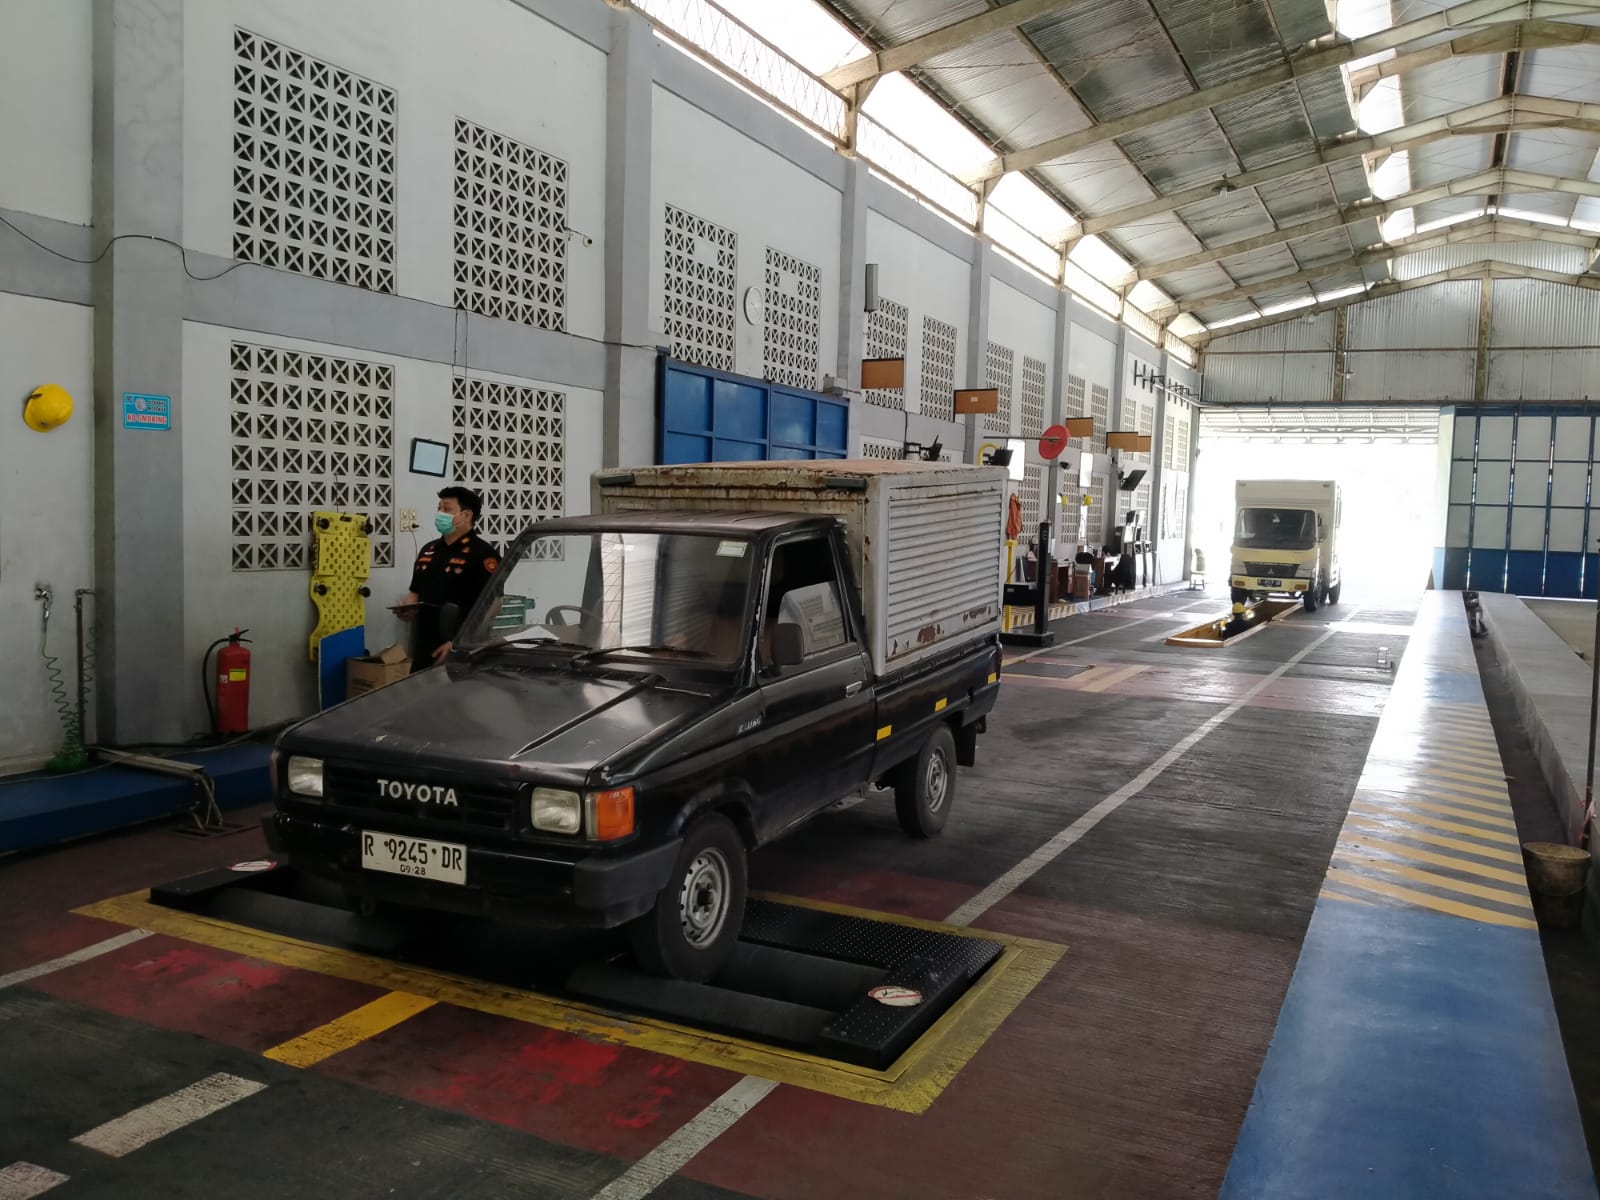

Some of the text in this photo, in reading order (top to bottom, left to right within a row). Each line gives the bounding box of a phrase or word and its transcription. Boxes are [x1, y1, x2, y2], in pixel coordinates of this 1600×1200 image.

[377, 779, 458, 806] TOYOTA
[364, 834, 462, 871] R 9245 DR
